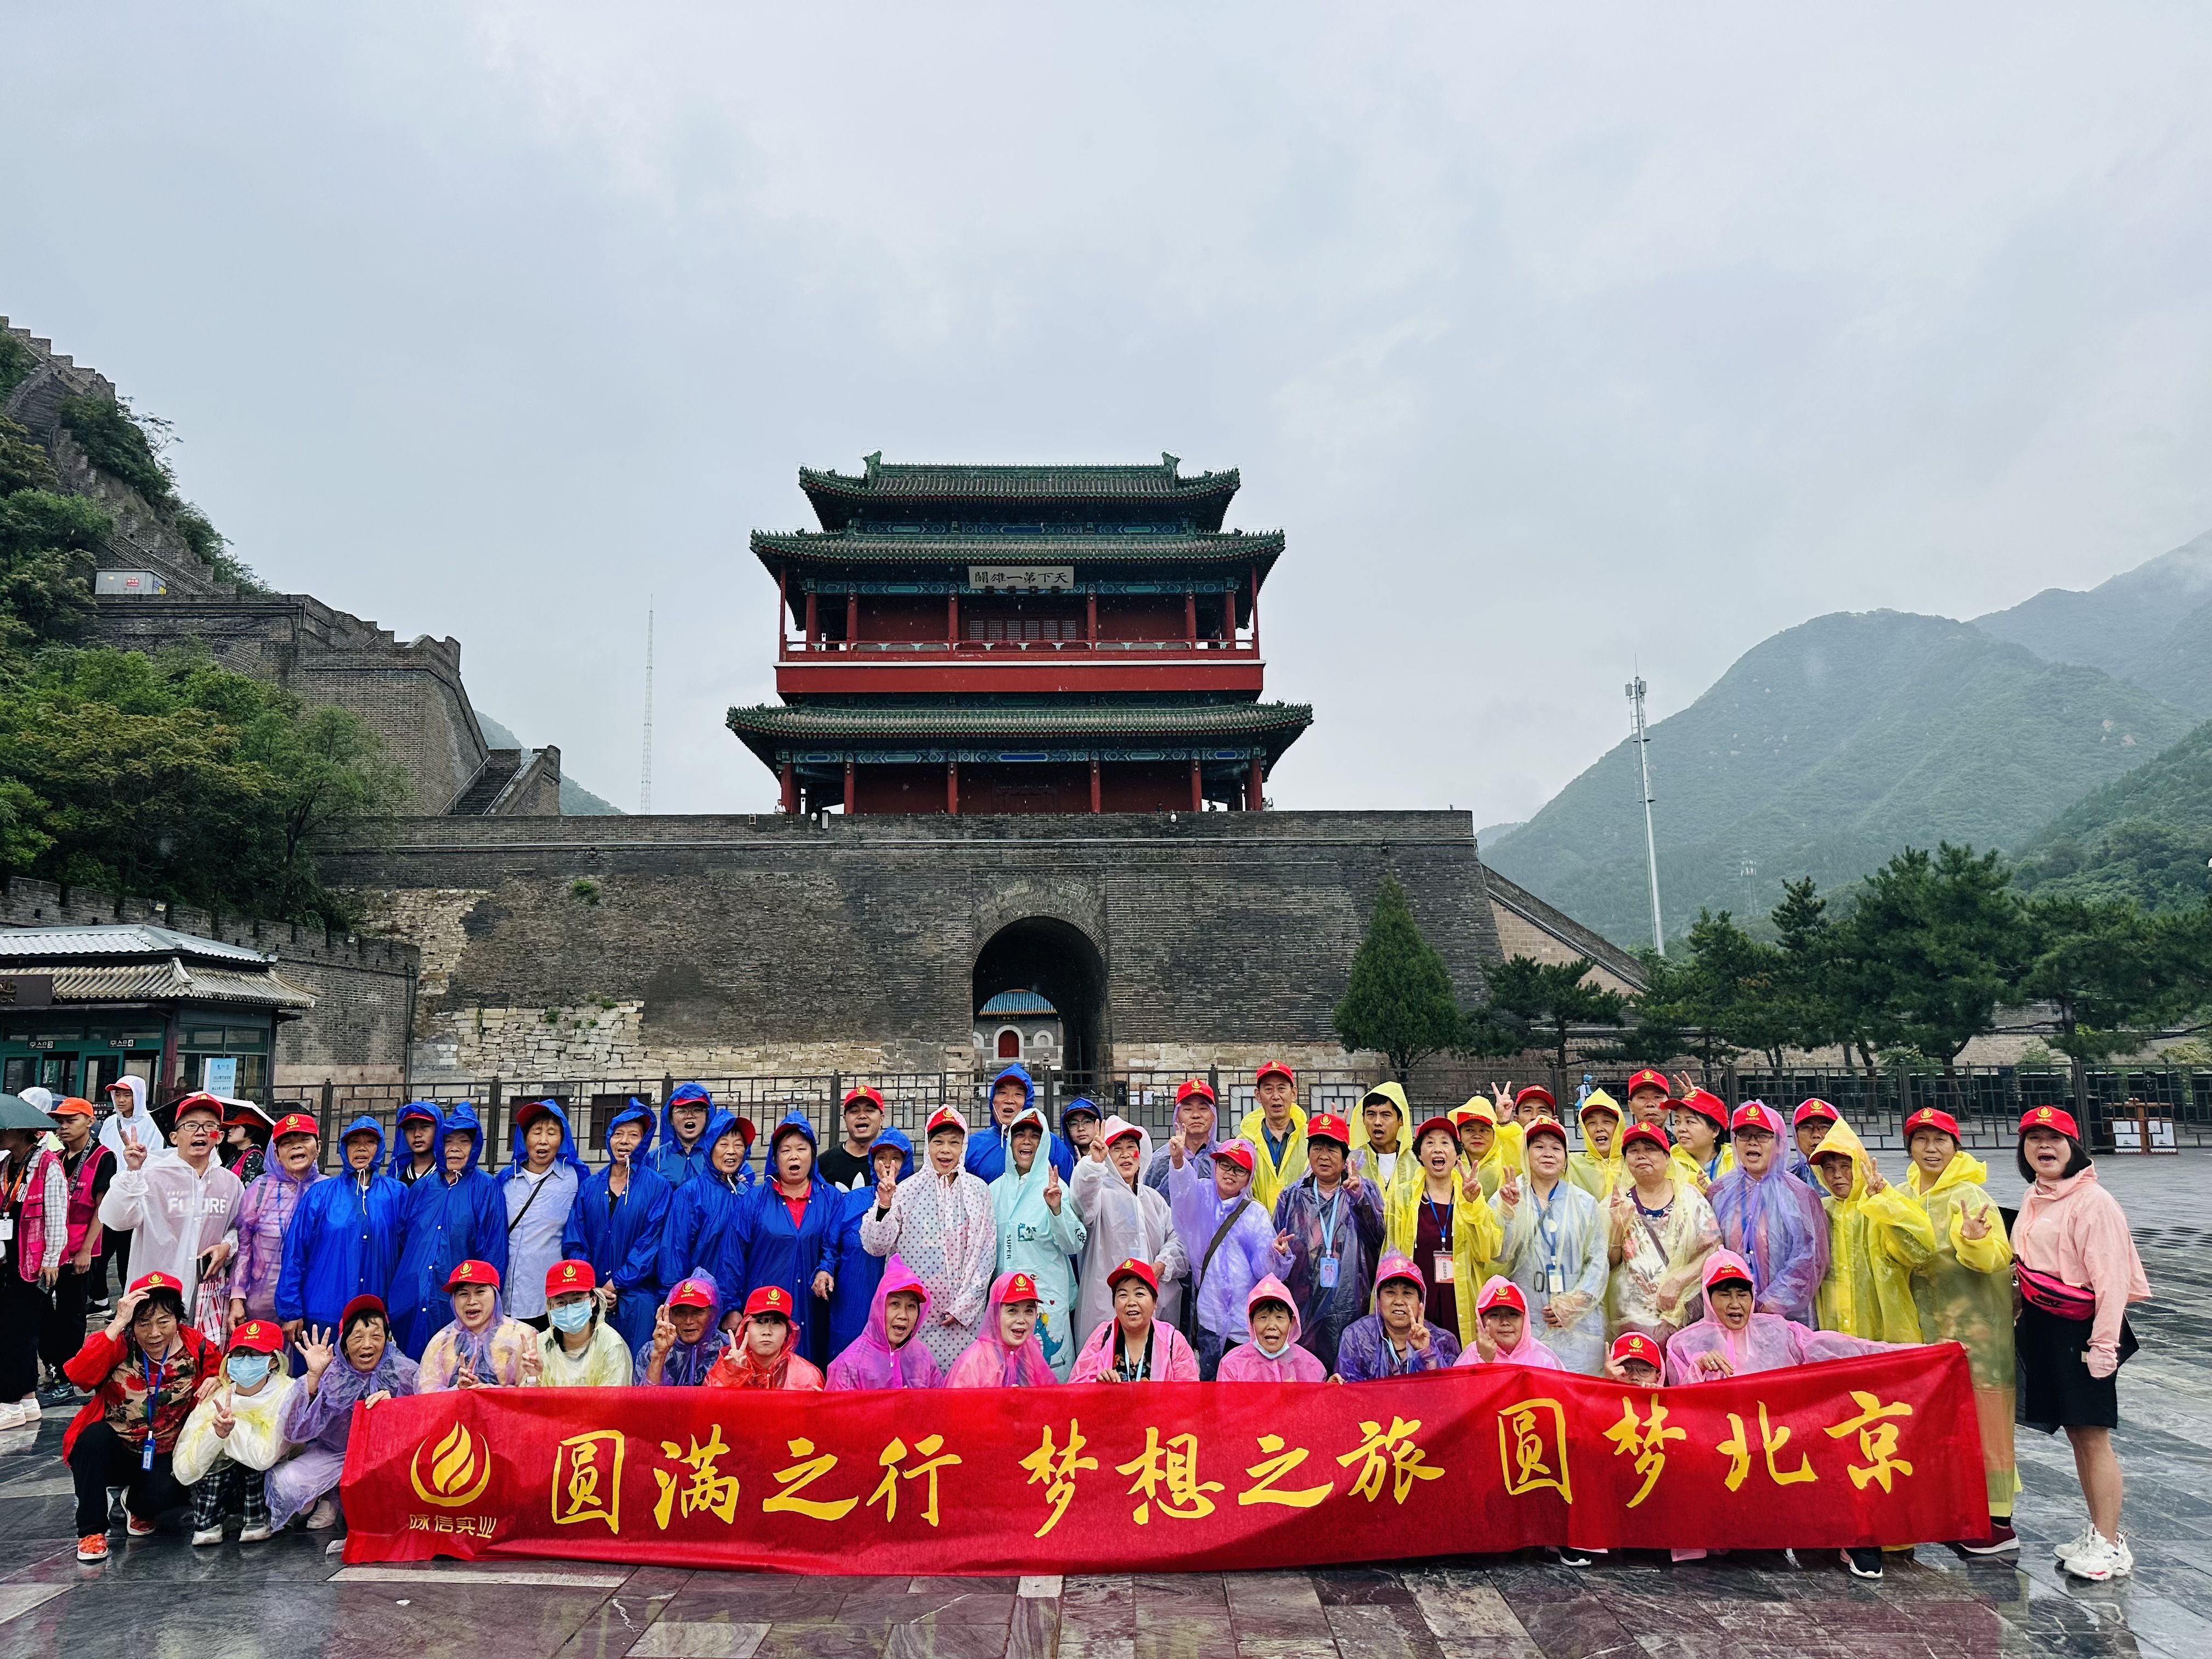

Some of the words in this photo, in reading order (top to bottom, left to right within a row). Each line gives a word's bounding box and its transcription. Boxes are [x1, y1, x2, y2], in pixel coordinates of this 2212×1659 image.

[551, 1424, 962, 1534] 圆满之行
[1019, 1415, 1445, 1537] 梦想之旅
[1498, 1391, 1913, 1508] 圆梦北京
